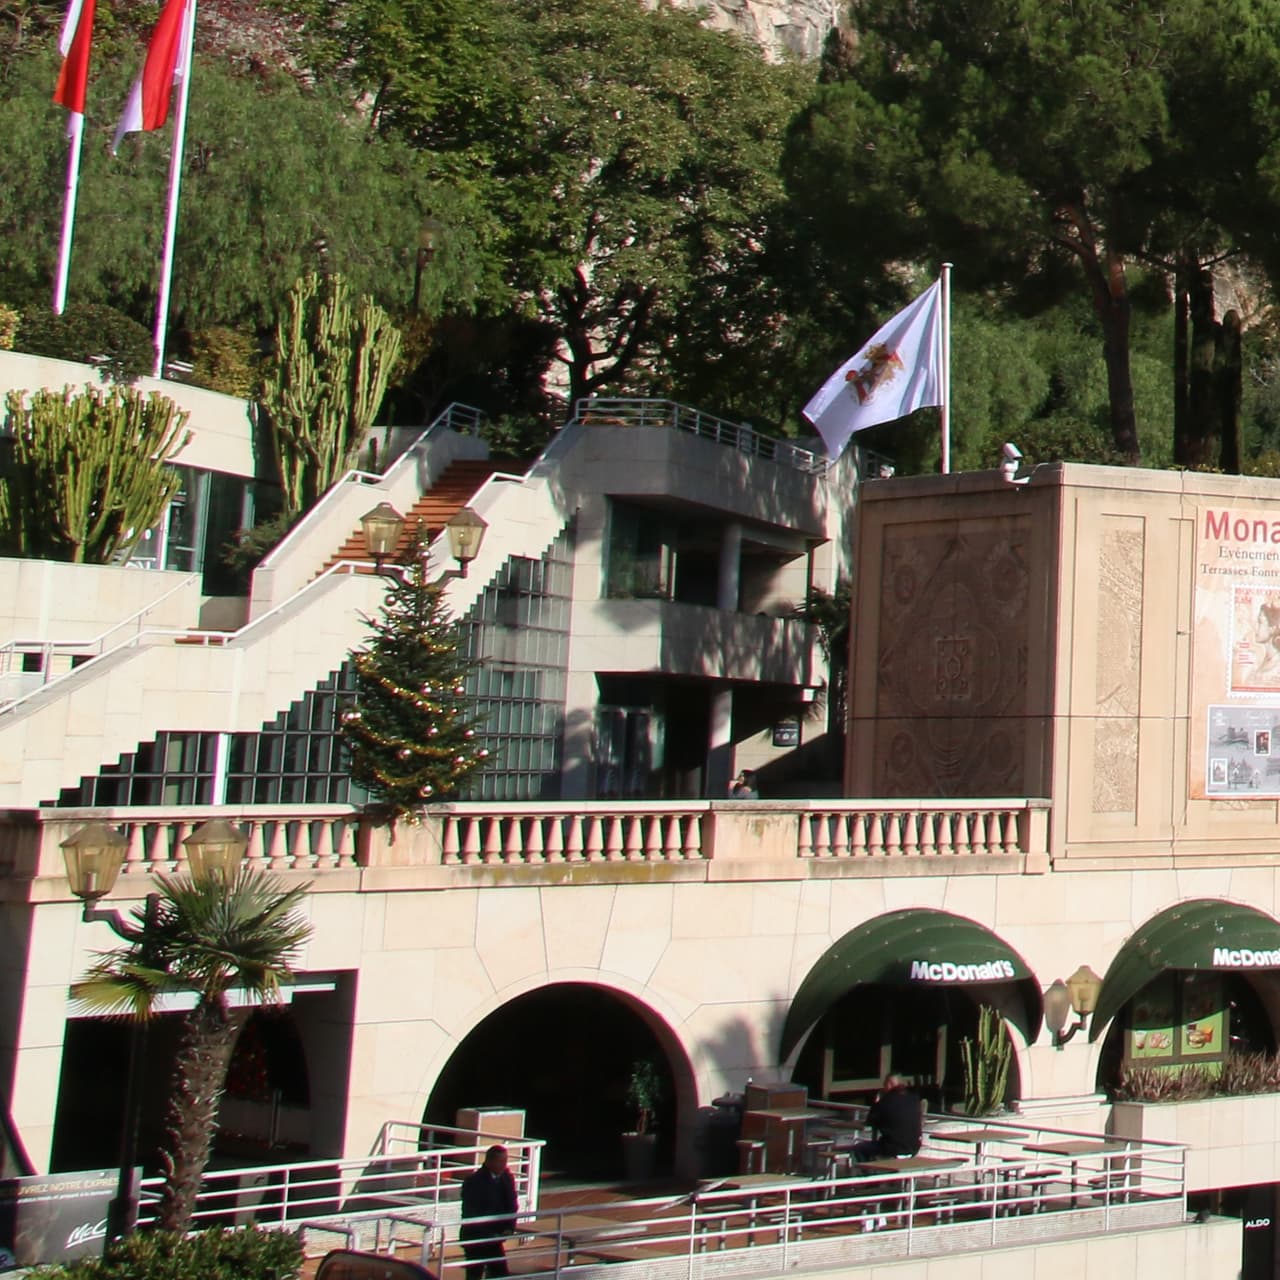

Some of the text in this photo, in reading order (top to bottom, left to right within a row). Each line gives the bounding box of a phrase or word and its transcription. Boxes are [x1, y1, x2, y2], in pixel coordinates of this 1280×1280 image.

[1200, 563, 1248, 576] Terrasses
[911, 960, 1015, 981] McDonald's
[50, 1179, 81, 1193] NOTRE
[1245, 1218, 1271, 1228] ALDO
